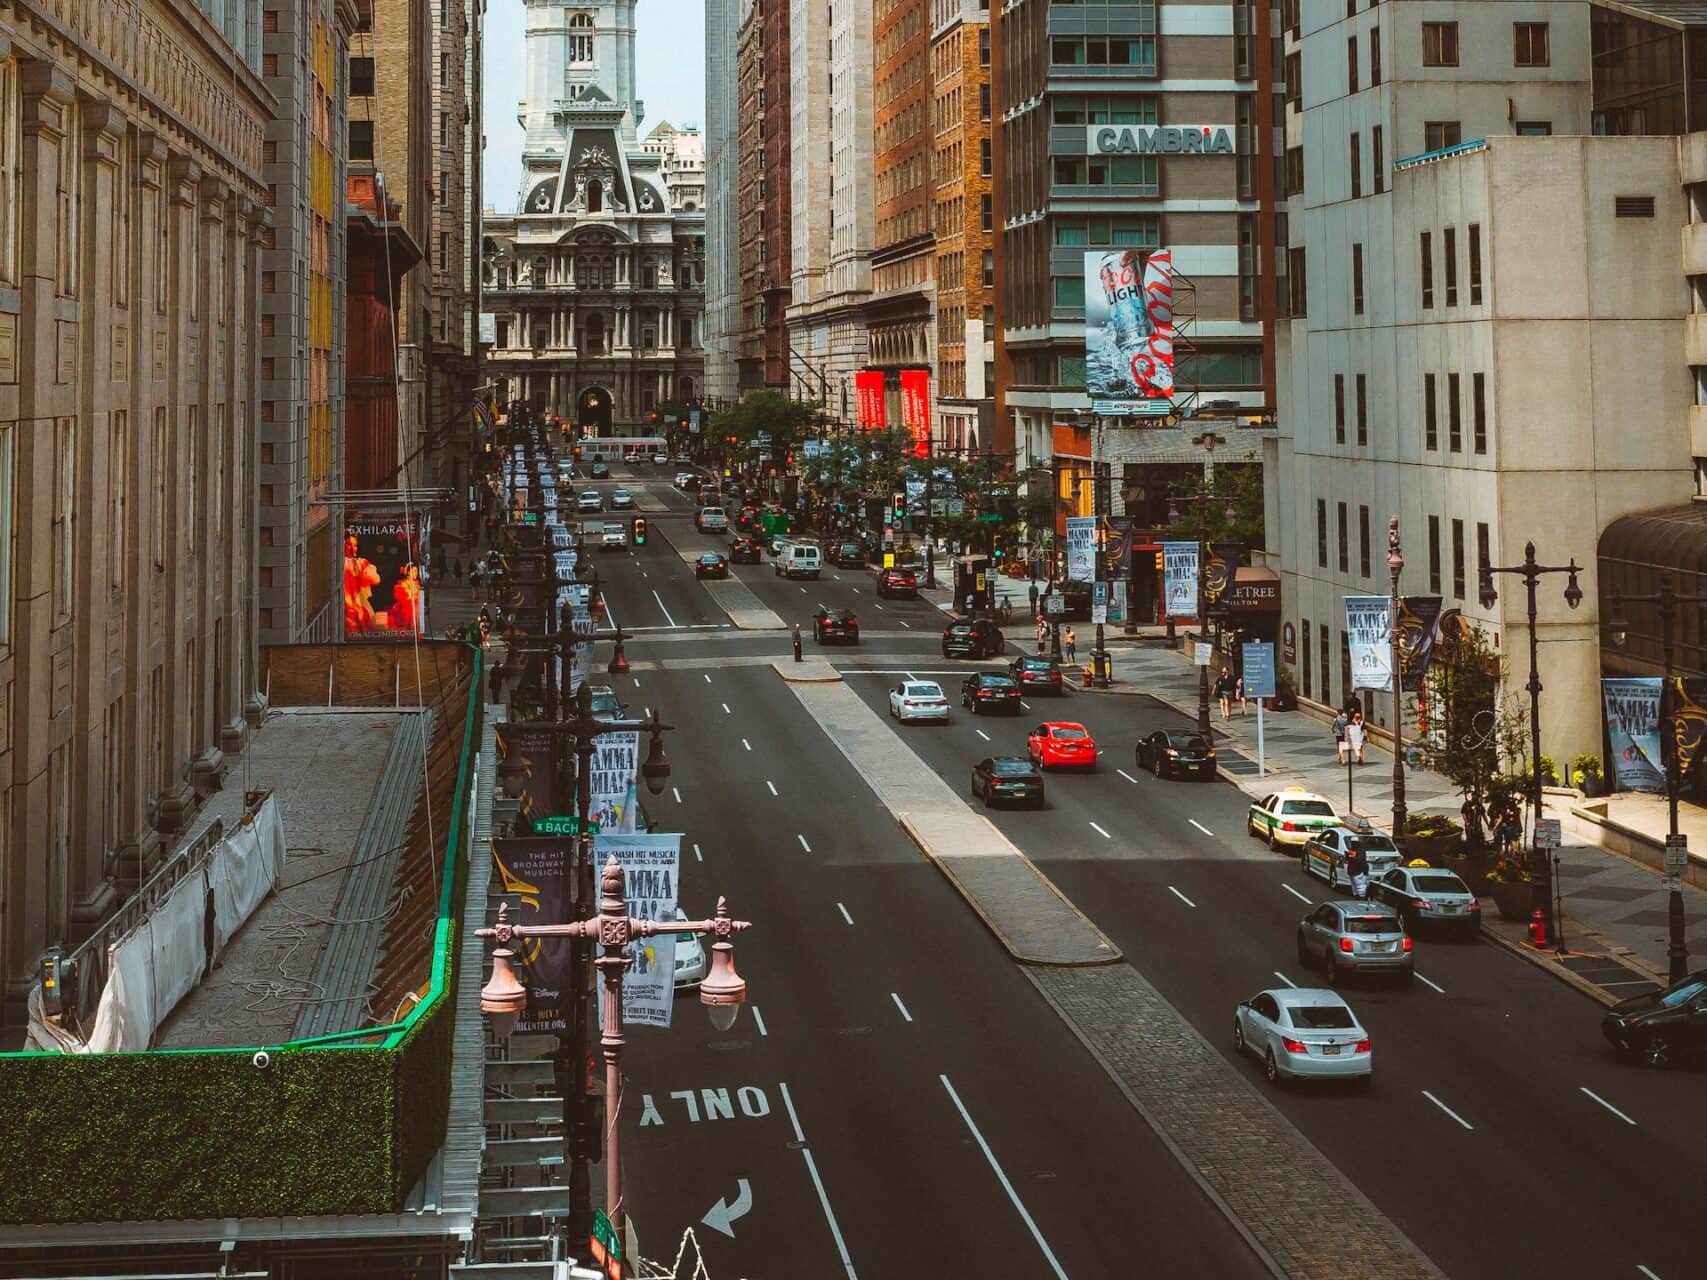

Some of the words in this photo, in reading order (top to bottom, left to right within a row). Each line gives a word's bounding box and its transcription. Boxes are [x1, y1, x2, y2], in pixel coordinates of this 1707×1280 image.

[1166, 556, 1196, 568] MAMMA
[1095, 587, 1106, 597] H
[592, 748, 635, 770] AMMA
[545, 822, 579, 833] BACH
[528, 852, 546, 860] THE
[550, 851, 565, 859] HIT
[512, 860, 565, 870] BROADWAY
[524, 868, 565, 877] MUSICAL
[531, 987, 561, 1000] Disney
[640, 1086, 771, 1126] ONLY
